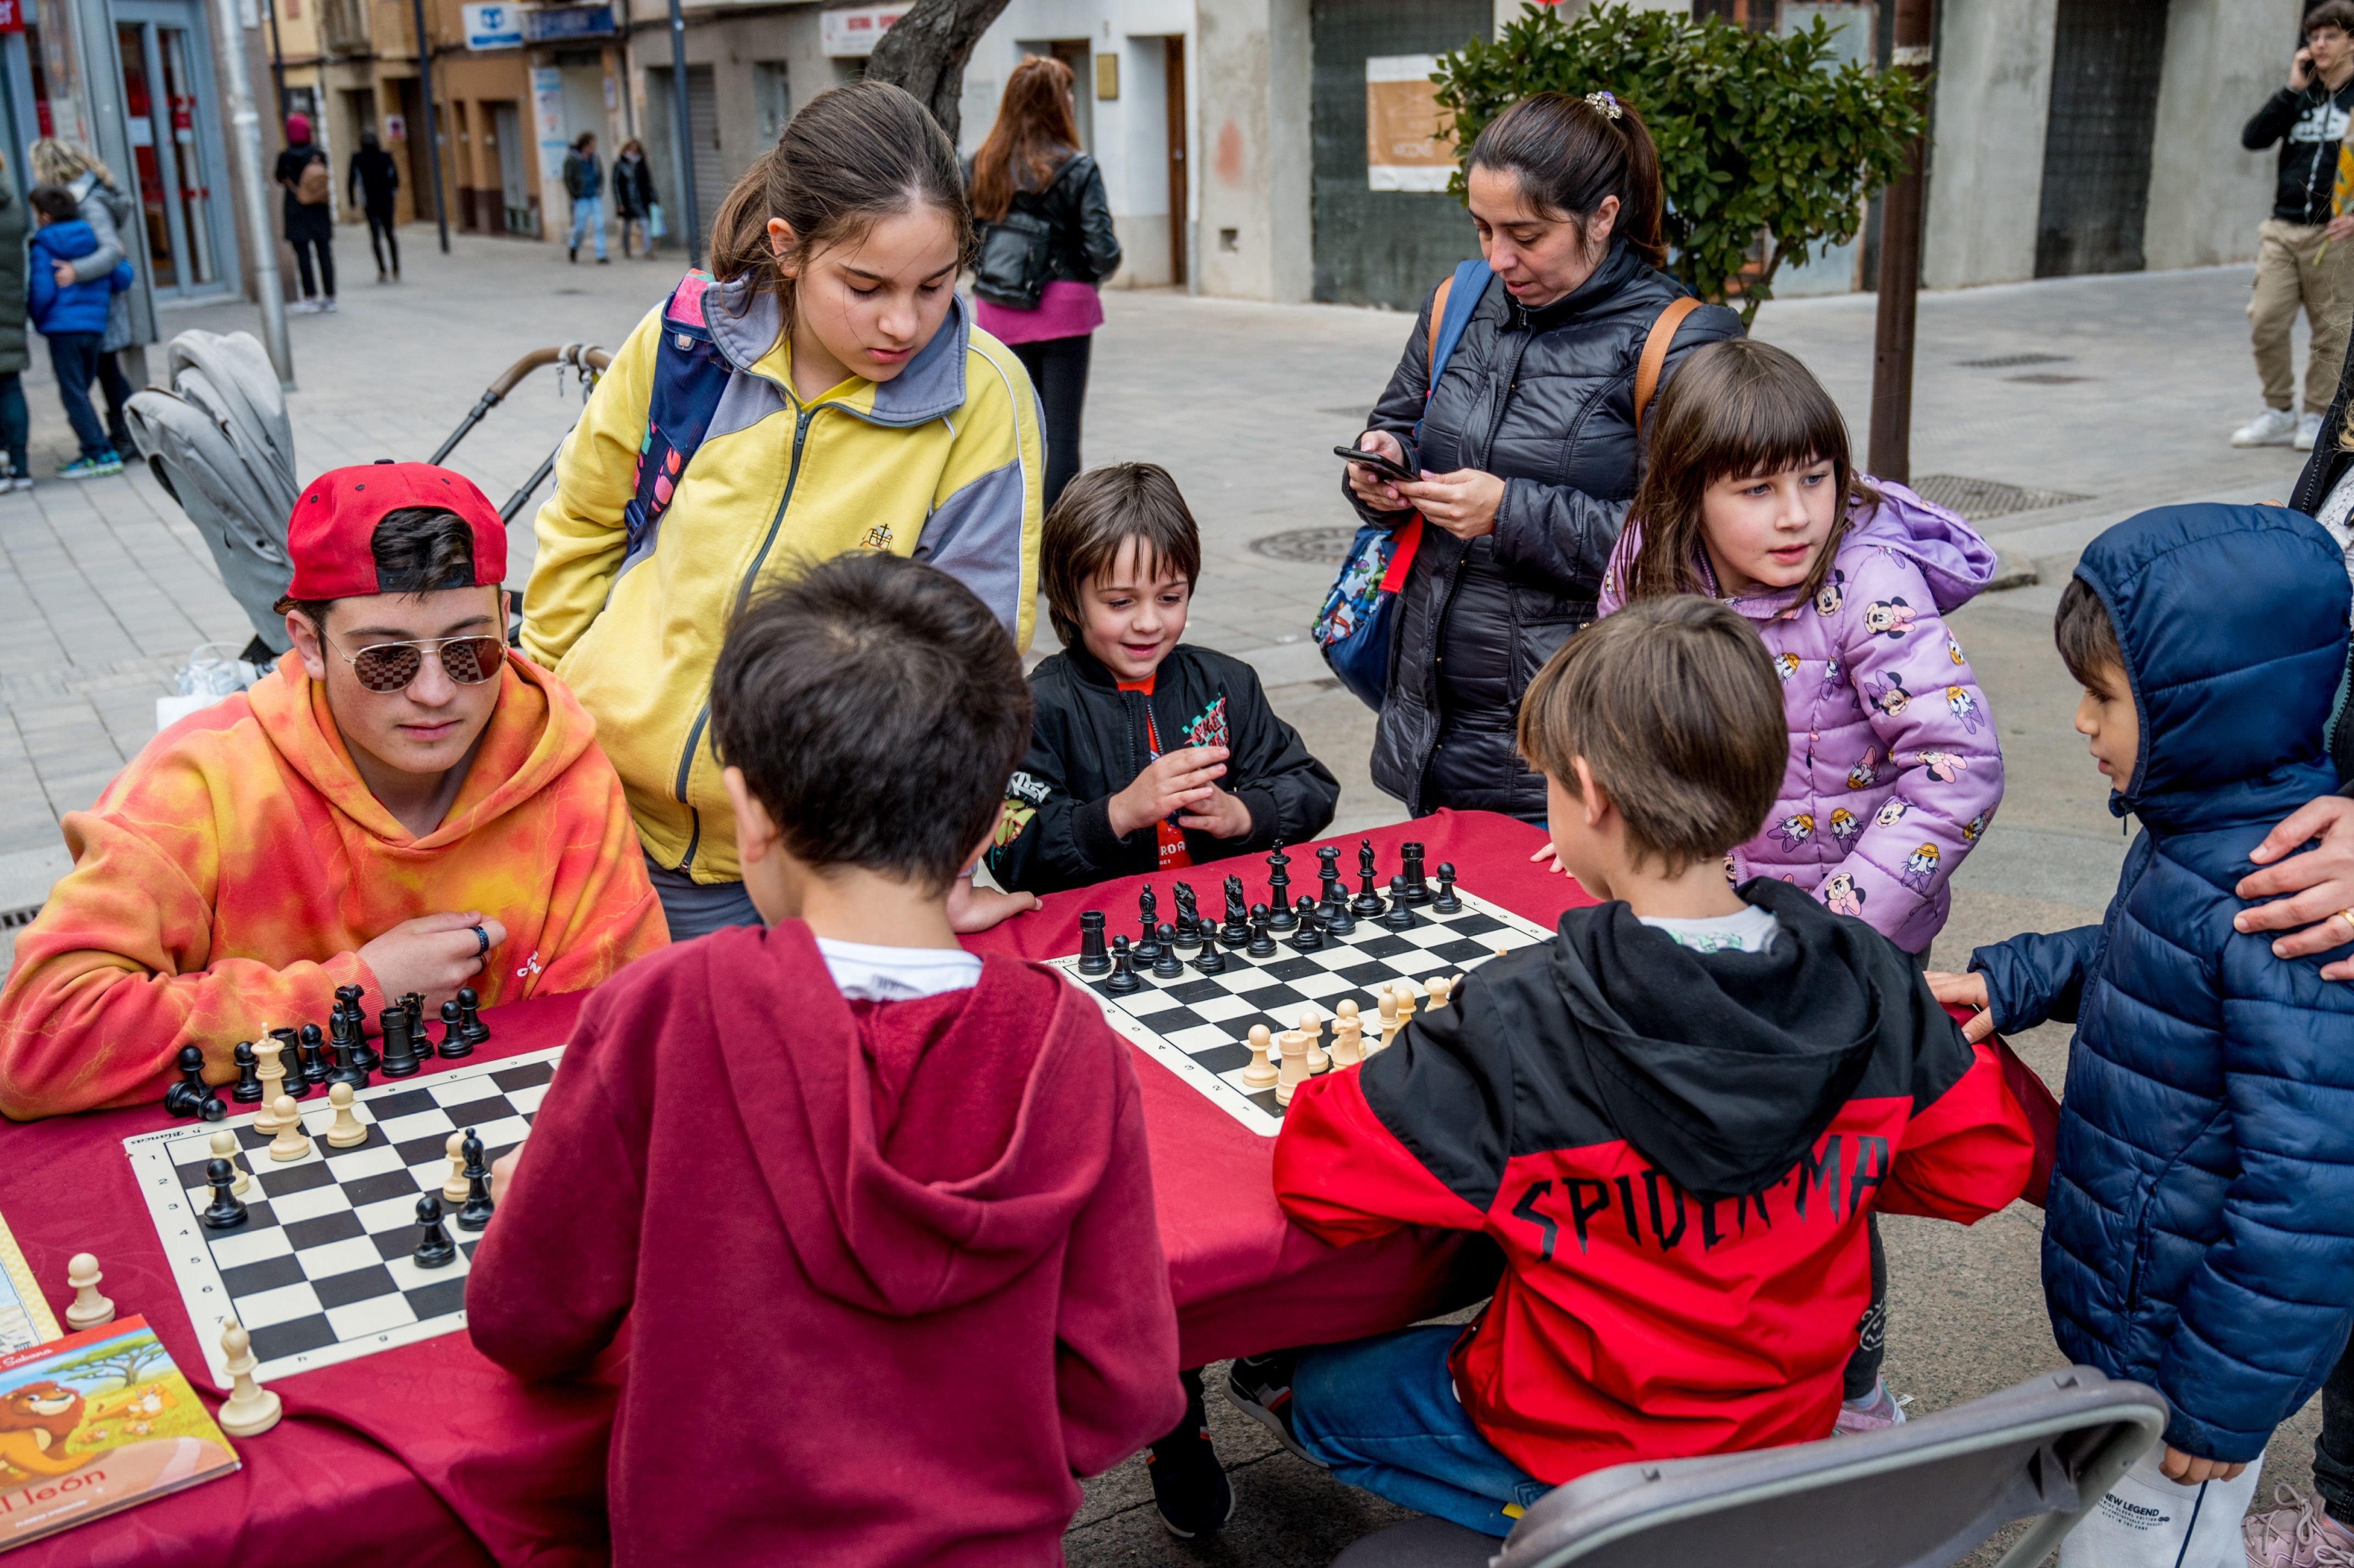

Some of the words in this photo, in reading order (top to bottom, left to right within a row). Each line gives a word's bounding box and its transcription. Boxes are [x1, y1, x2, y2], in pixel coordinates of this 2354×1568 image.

[131, 1130, 184, 1145] Blancas
[2, 1348, 54, 1367] Sabana
[23, 1470, 106, 1505] león
[2123, 1502, 2160, 1517] LEGEND
